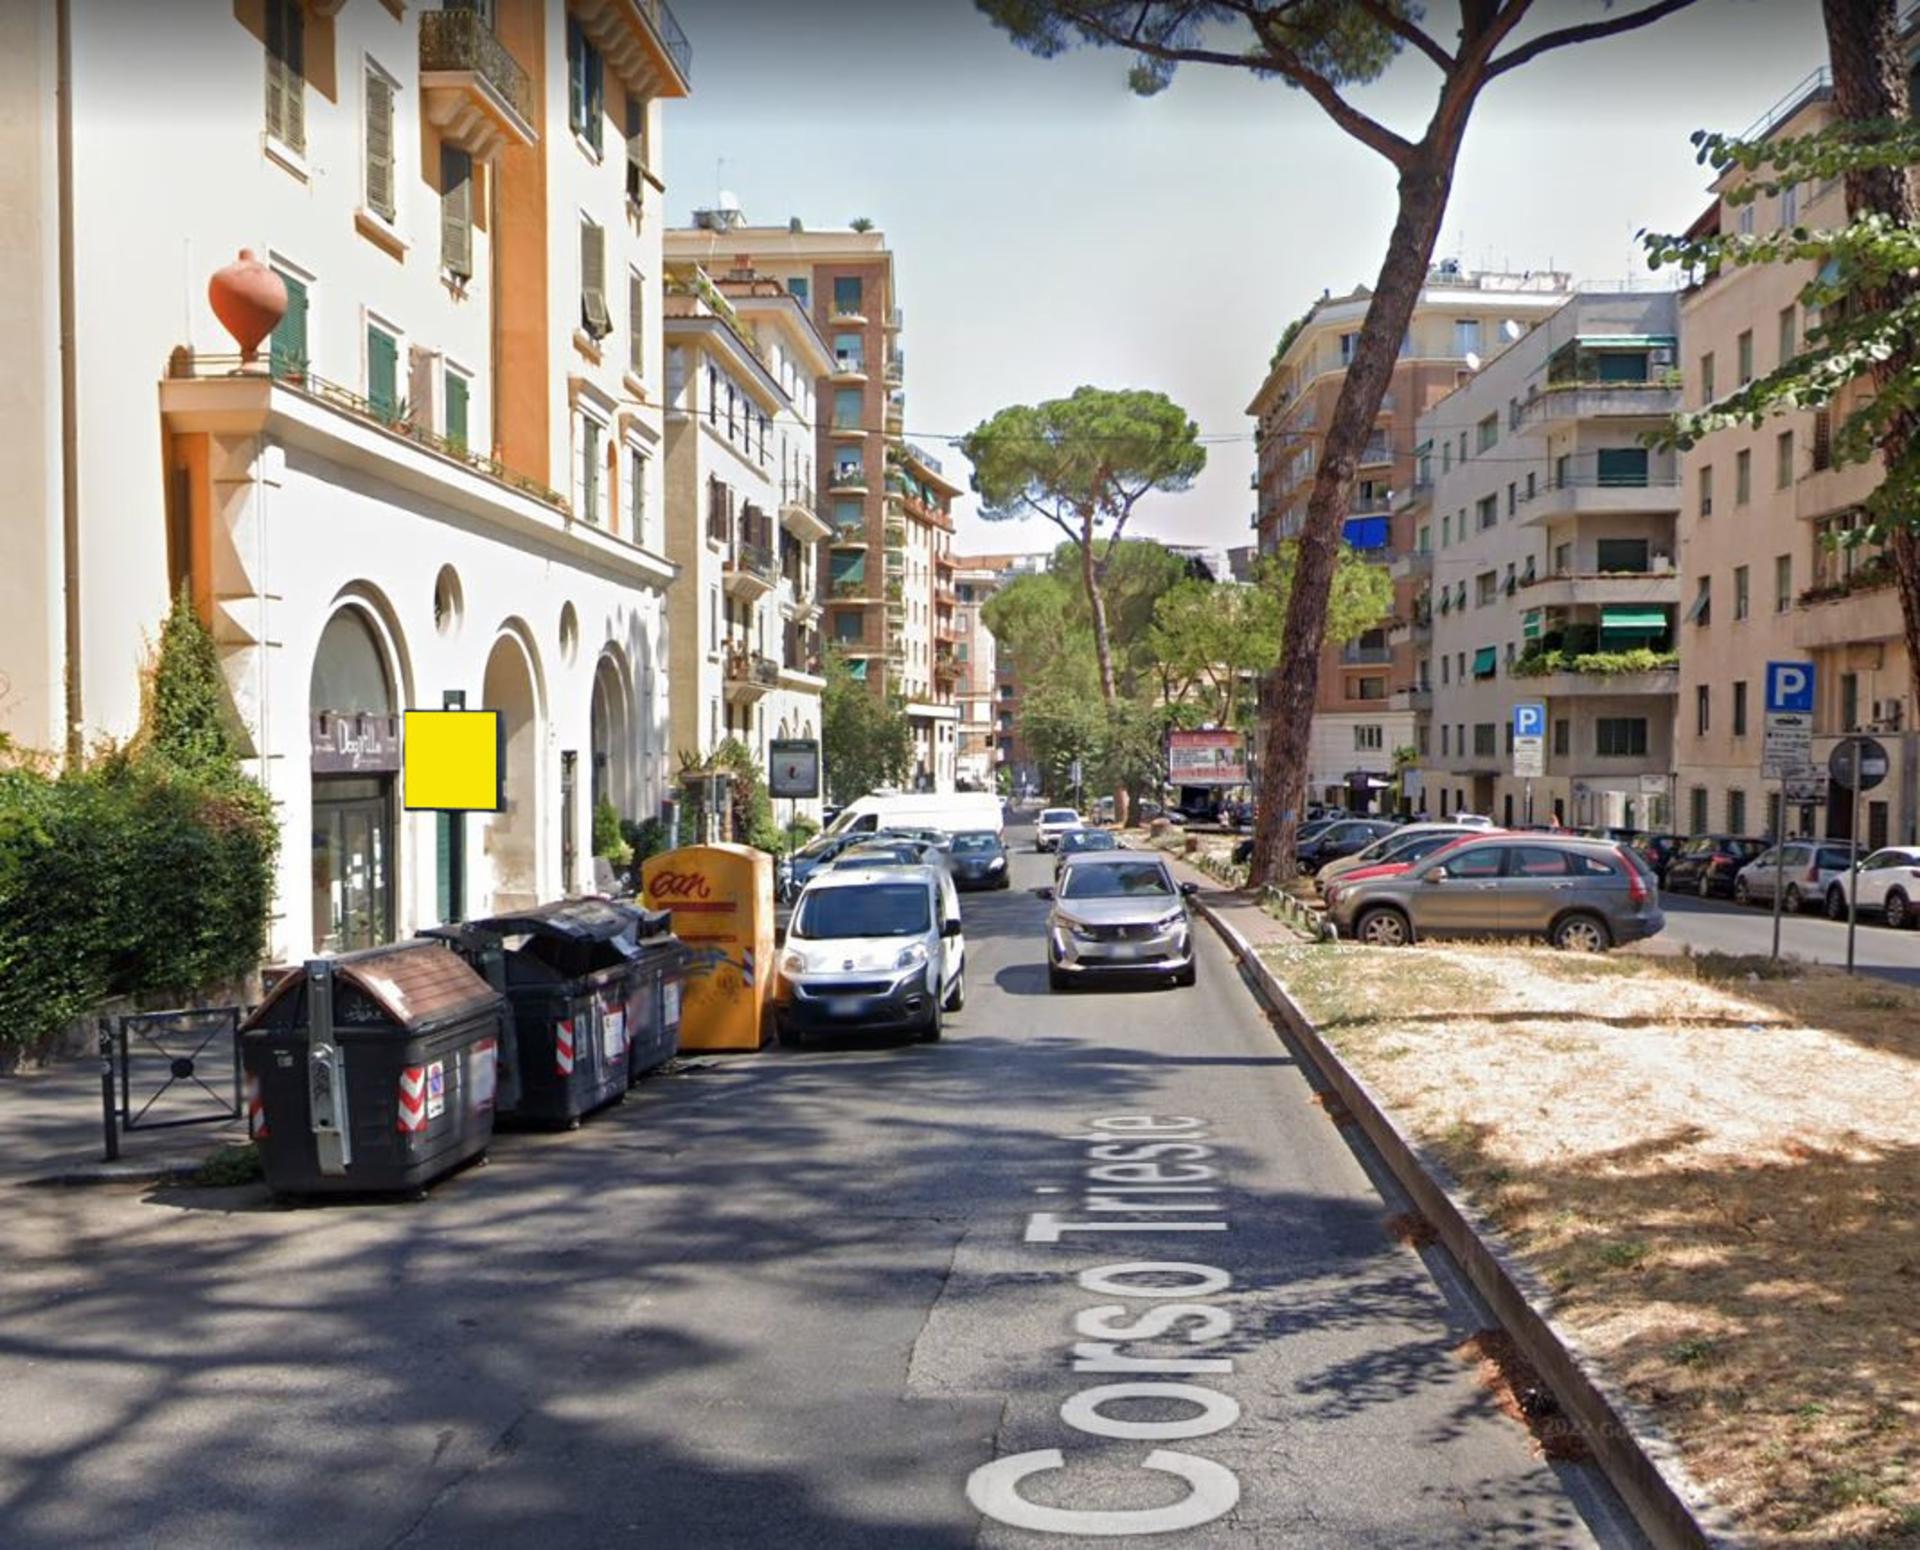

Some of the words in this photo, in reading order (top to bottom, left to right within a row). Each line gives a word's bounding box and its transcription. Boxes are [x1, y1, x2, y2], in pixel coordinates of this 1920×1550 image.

[1518, 707, 1538, 734] P
[1774, 666, 1807, 706] P
[1025, 1114, 1228, 1242] Trieste
[966, 1261, 1240, 1536] Corso
